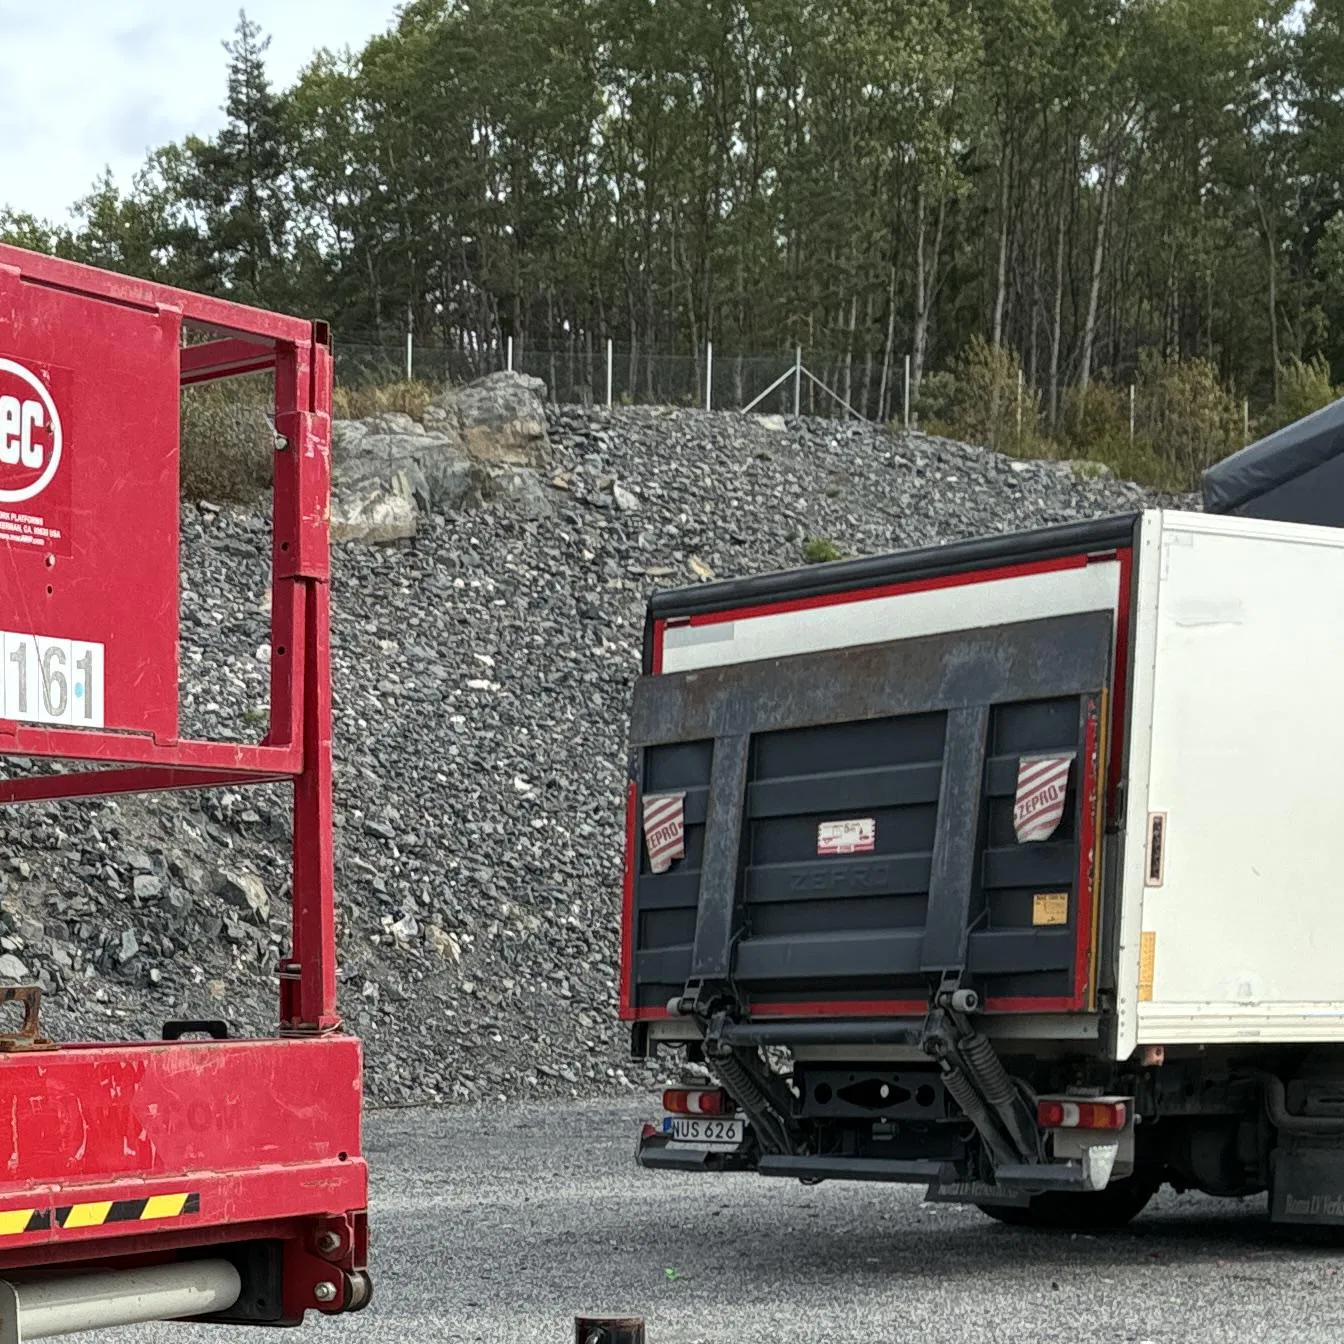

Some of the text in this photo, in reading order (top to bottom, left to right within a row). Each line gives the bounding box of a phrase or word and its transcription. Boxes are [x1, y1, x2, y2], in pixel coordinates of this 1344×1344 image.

[1018, 785, 1059, 820] ZEPRO
[672, 1120, 736, 1140] NUS 626
